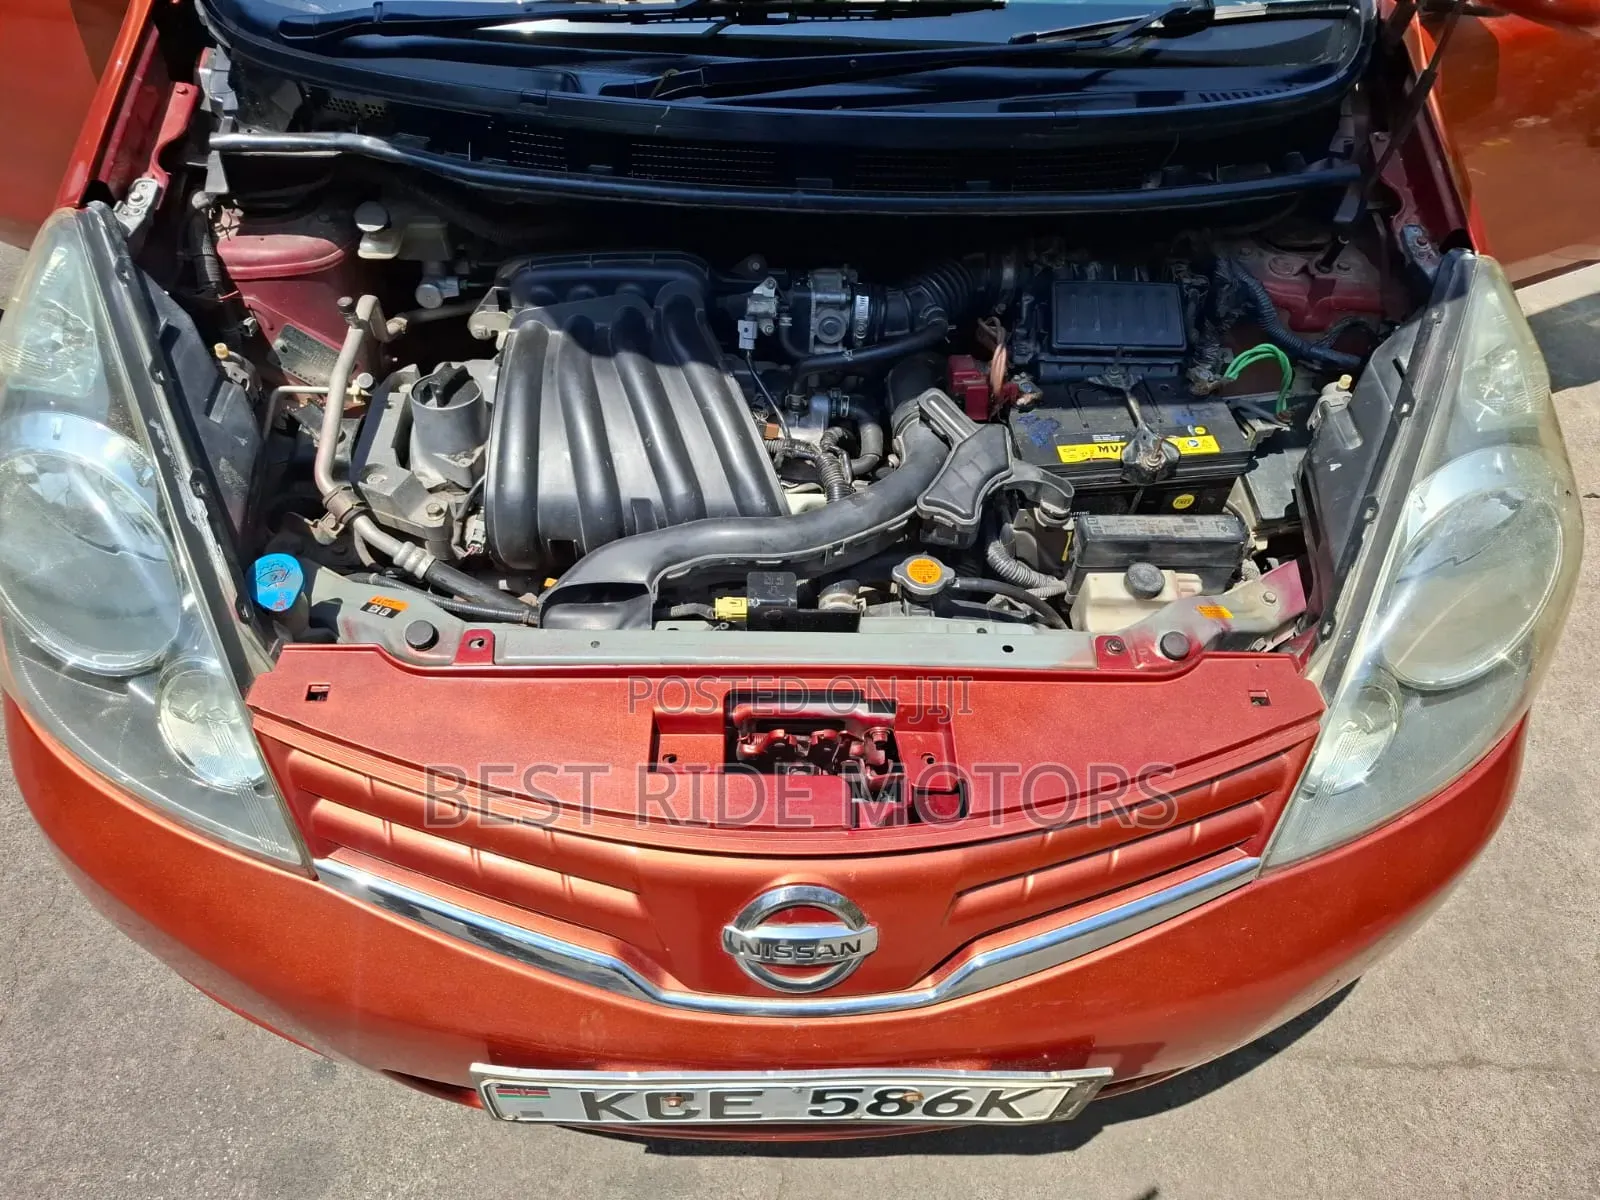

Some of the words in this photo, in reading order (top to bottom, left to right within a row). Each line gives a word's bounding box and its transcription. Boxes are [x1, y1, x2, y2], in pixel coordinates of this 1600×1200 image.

[739, 939, 861, 960] NISSAN
[579, 1090, 764, 1121] KCE
[807, 1087, 1044, 1118] 586K
